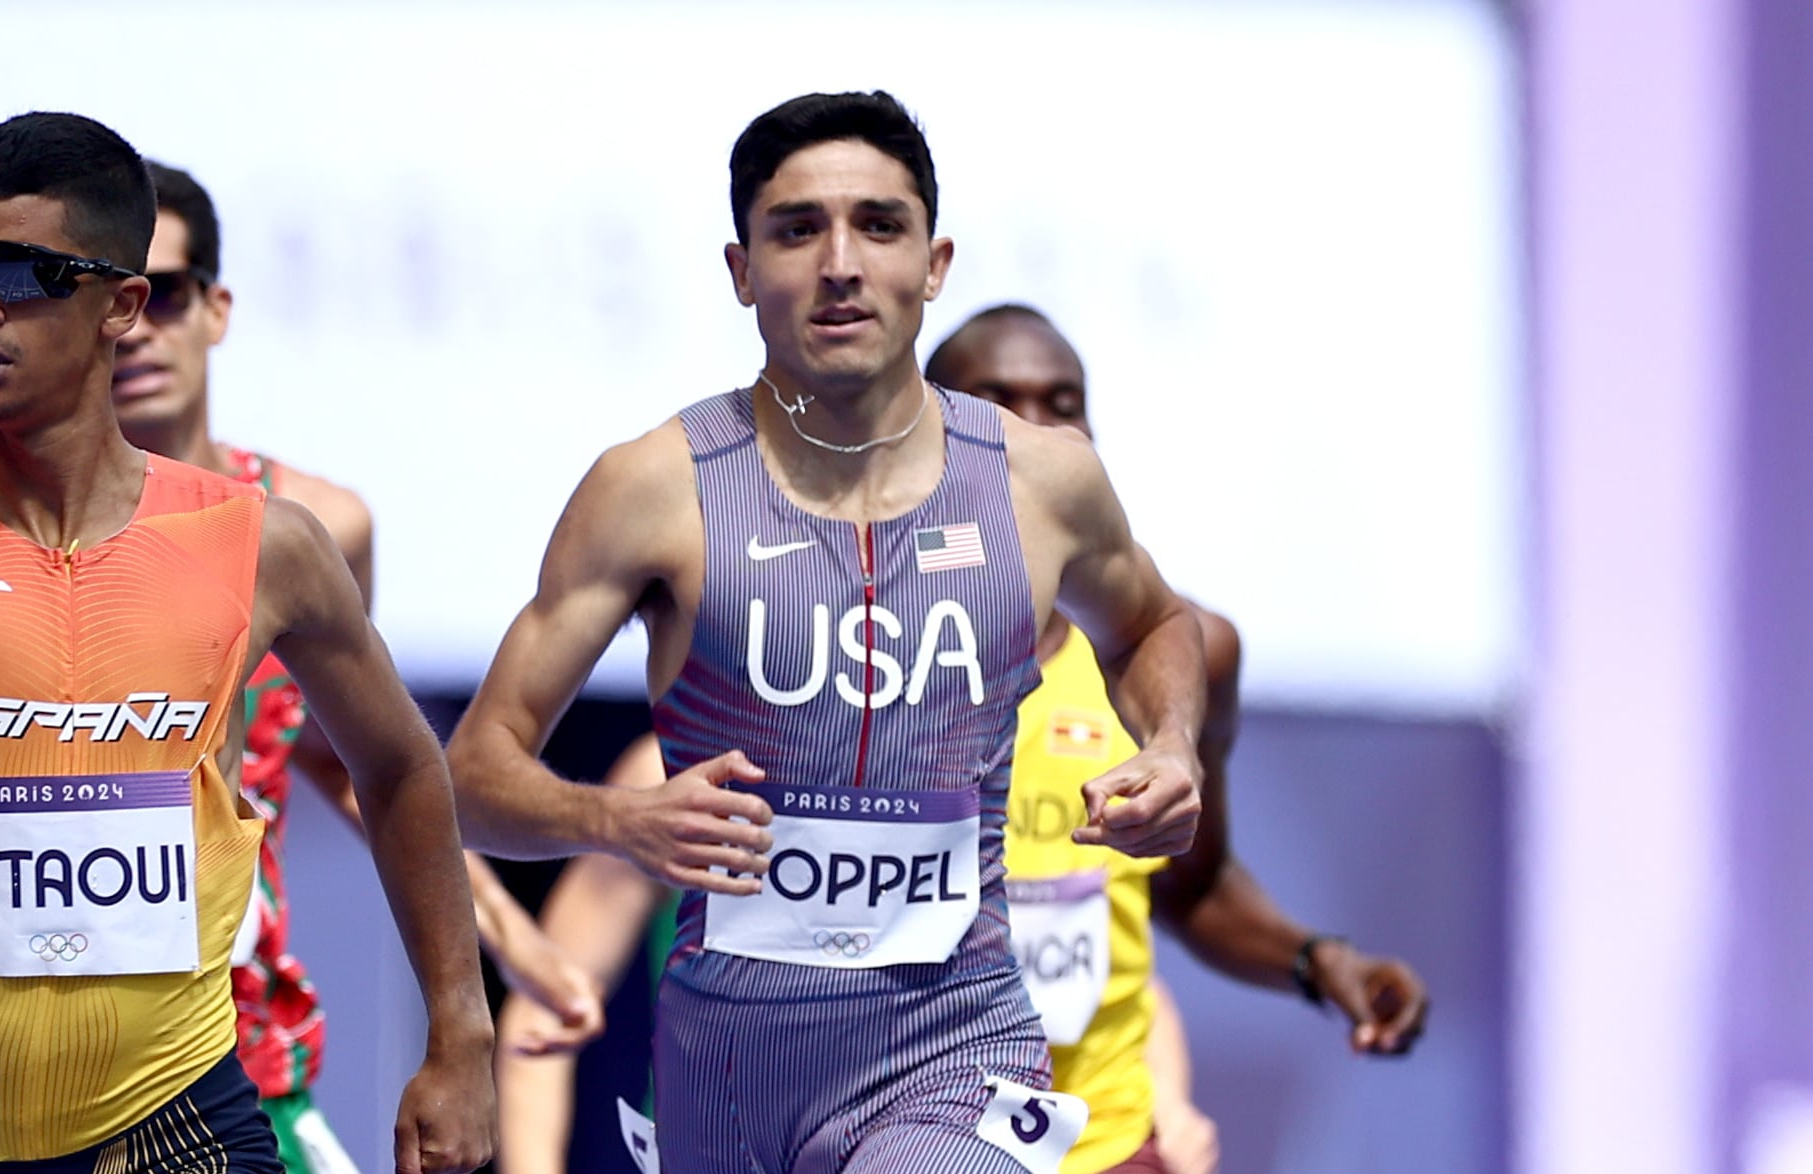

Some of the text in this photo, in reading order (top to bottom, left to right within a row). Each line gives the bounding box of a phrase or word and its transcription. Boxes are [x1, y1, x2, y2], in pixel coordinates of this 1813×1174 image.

[746, 598, 985, 709] USA
[61, 782, 124, 802] 2024
[783, 791, 920, 815] PARIS 2024
[727, 846, 967, 907] OPPEL
[1010, 1096, 1057, 1144] 5
